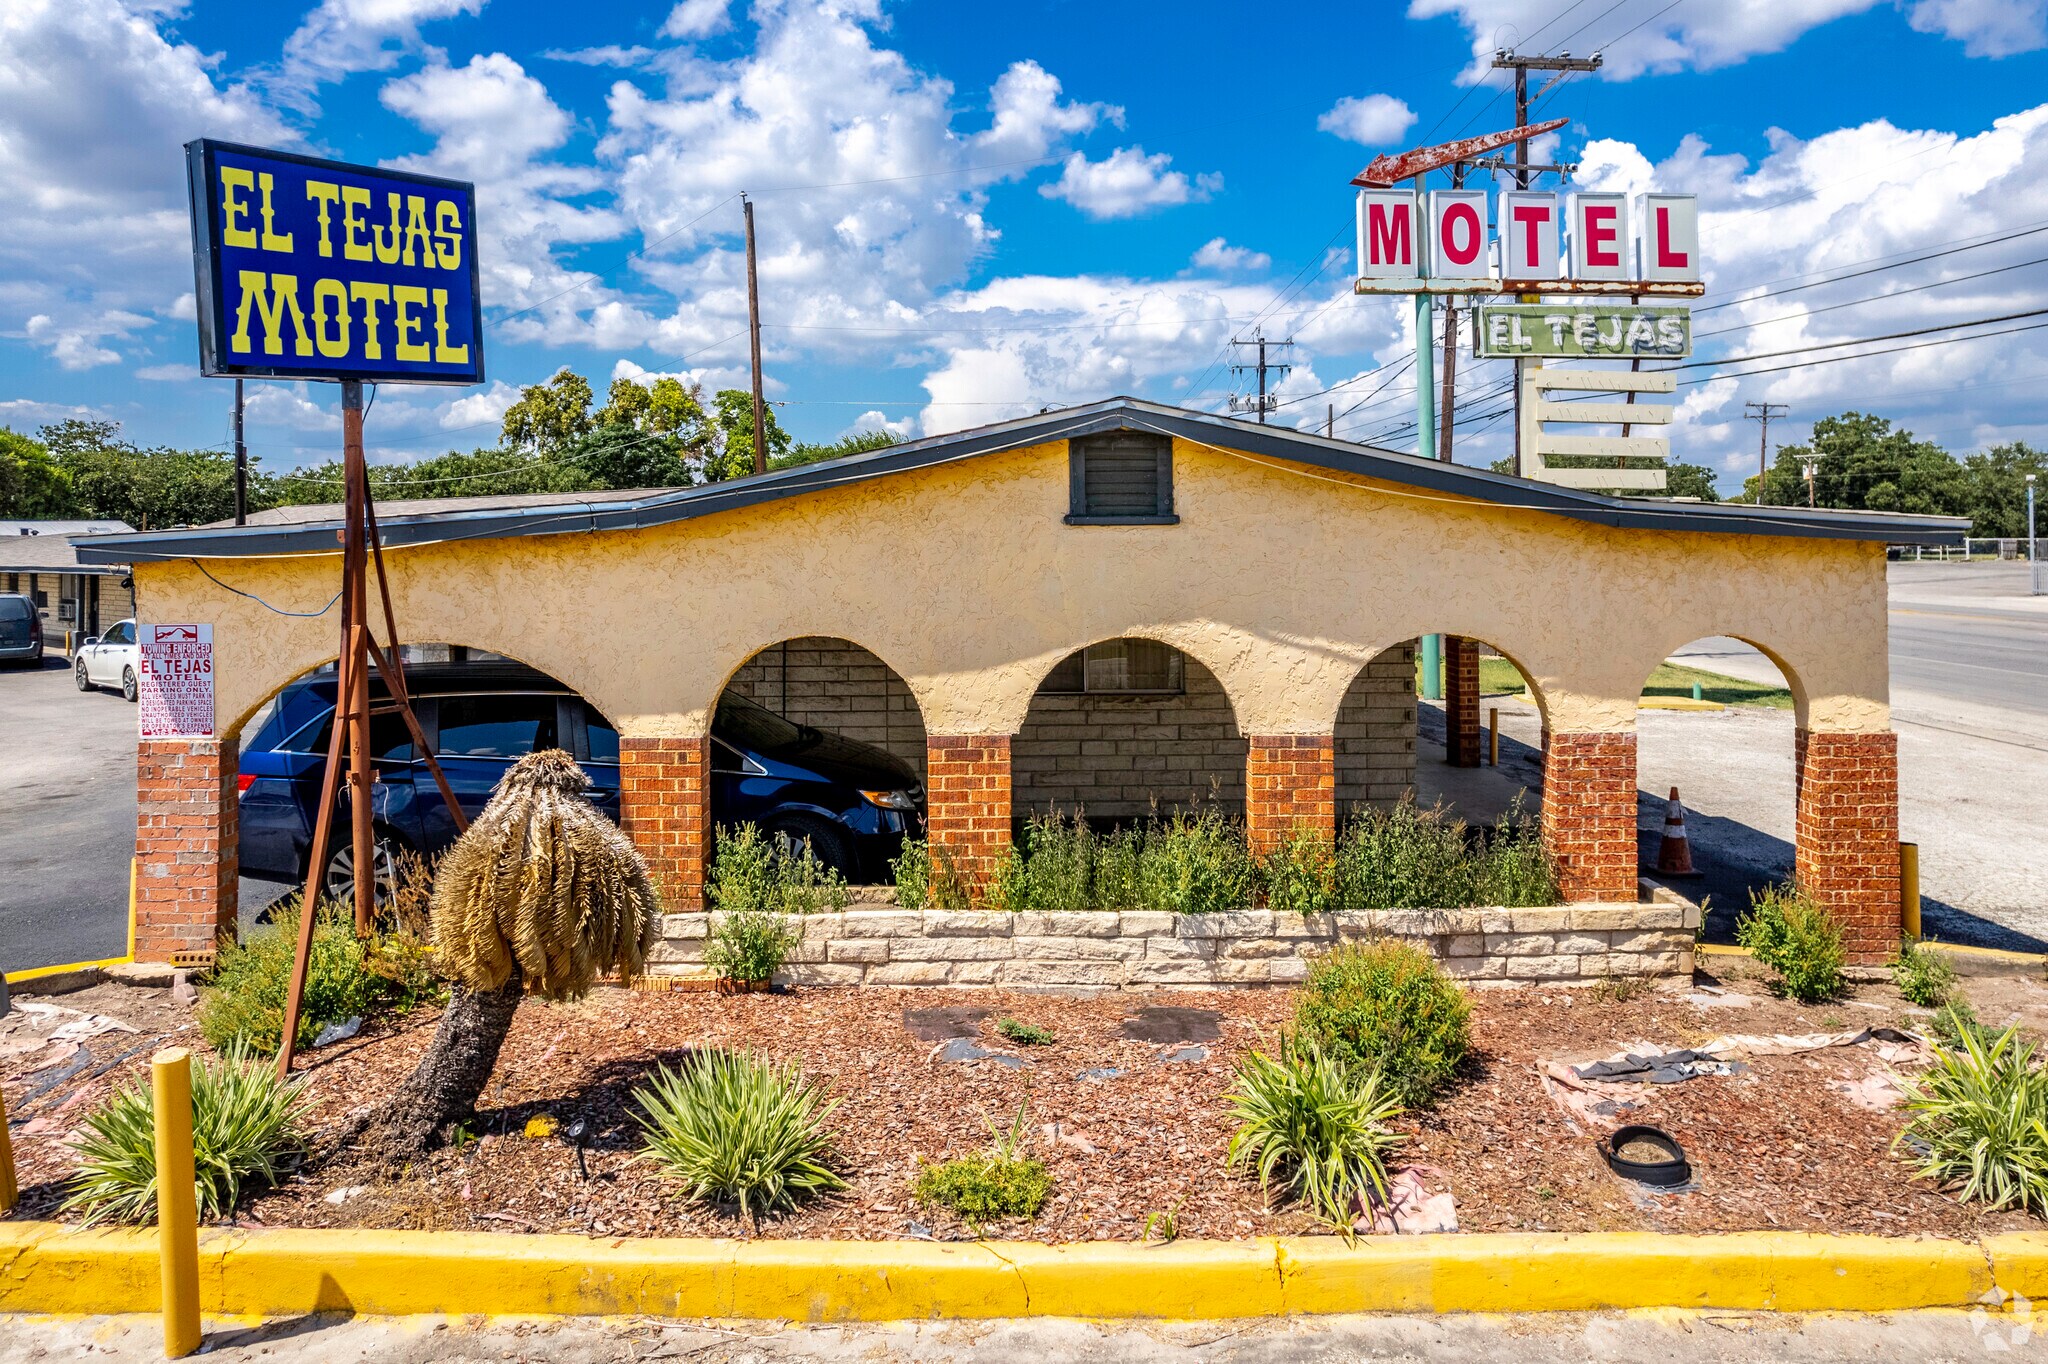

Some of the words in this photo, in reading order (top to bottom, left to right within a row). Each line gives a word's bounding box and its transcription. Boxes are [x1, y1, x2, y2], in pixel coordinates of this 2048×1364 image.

[220, 165, 294, 254] EL
[306, 180, 462, 271] TEJAS
[1369, 202, 1688, 268] MOTEL
[231, 270, 469, 364] MOTEL
[1489, 313, 1533, 347] EL
[1544, 313, 1684, 351] TEJAS
[141, 660, 159, 673] EL
[164, 659, 211, 673] TEJAS
[143, 644, 171, 653] TOWING
[173, 644, 210, 653] ENFORCED
